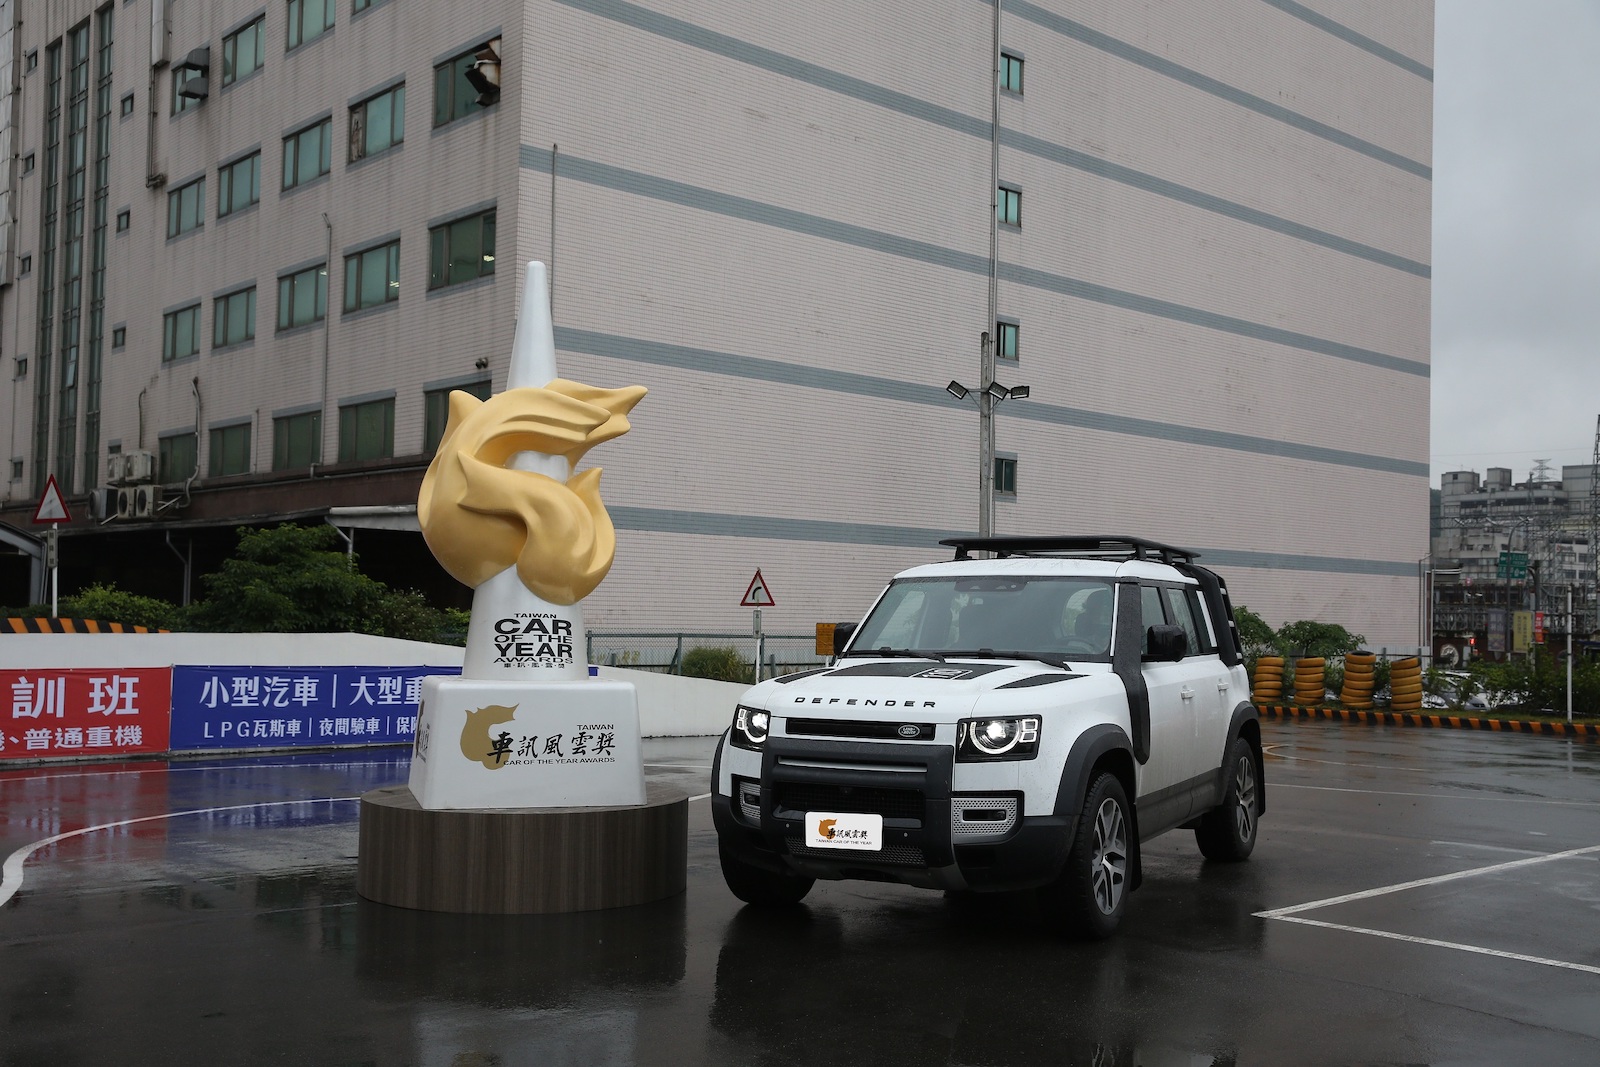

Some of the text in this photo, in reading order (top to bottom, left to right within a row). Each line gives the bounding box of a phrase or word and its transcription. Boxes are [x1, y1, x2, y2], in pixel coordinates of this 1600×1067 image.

[494, 618, 572, 635] CAR
[494, 634, 573, 644] OF THE
[494, 642, 573, 658] YEAR
[493, 656, 573, 664] AWARDS
[199, 676, 319, 708] 小型汽車
[794, 697, 936, 708] DEFENDER
[319, 717, 381, 736] 夜間驗車
[486, 731, 616, 764] 車訊風雲獎
